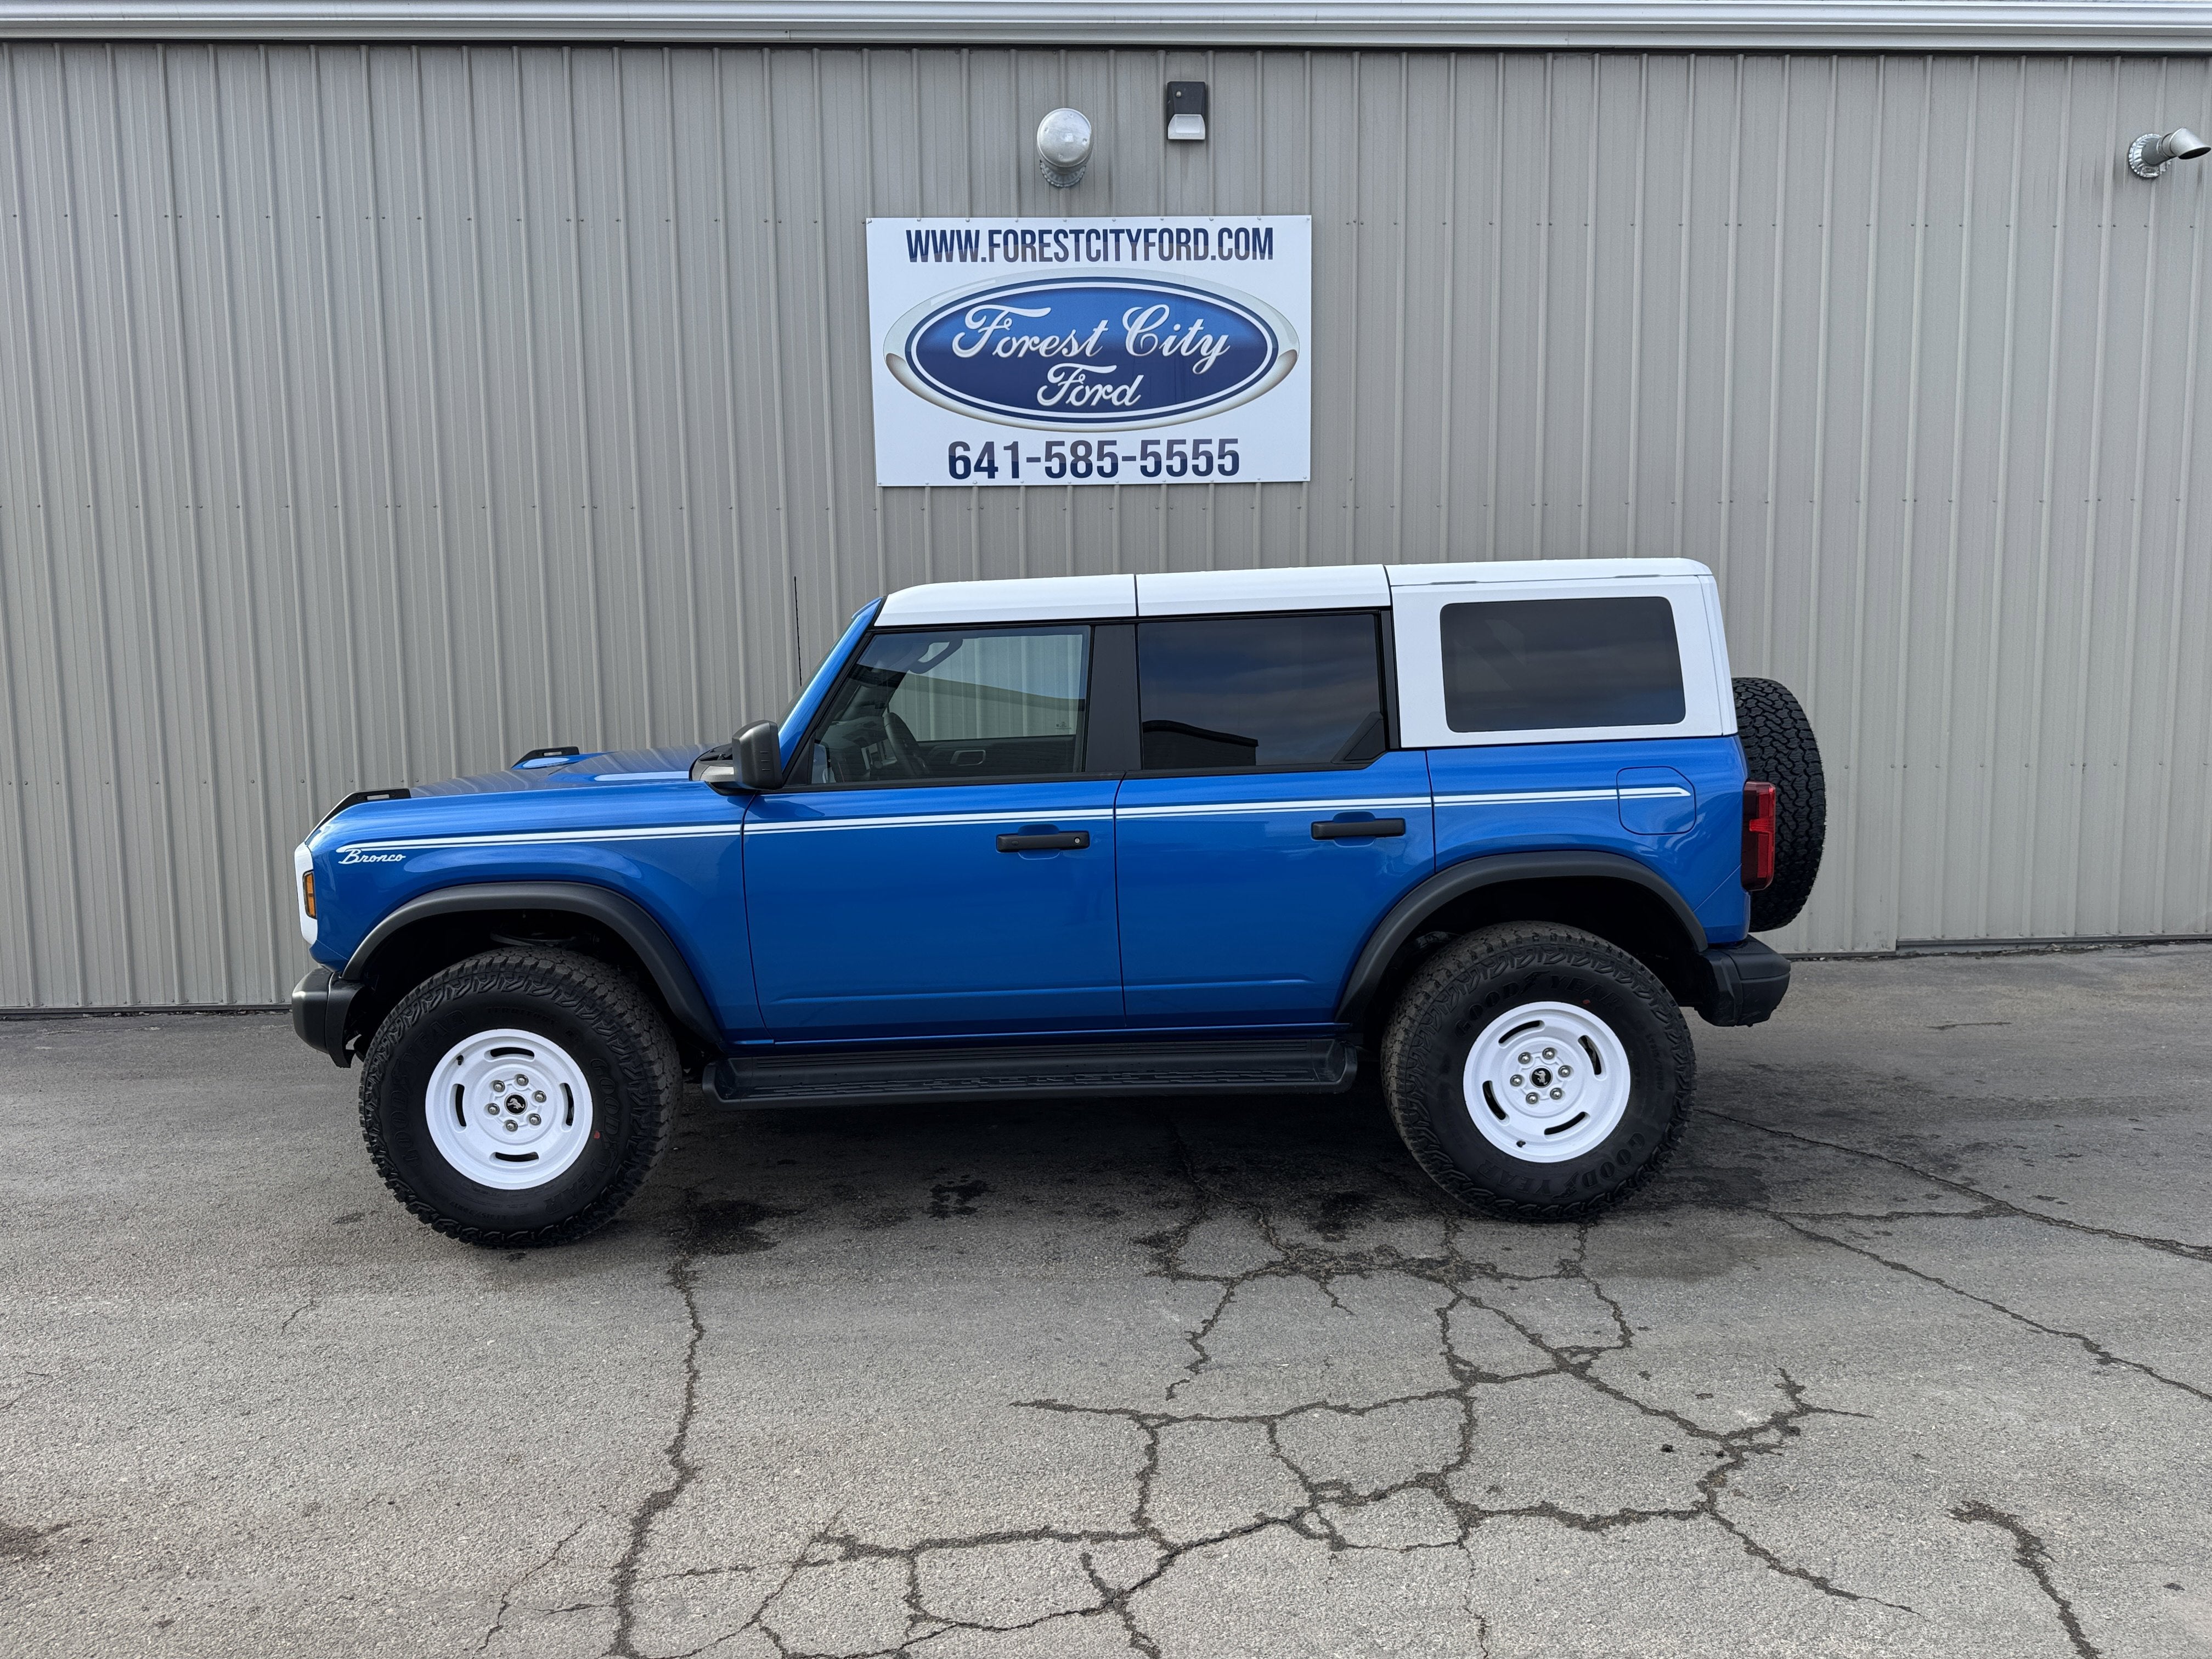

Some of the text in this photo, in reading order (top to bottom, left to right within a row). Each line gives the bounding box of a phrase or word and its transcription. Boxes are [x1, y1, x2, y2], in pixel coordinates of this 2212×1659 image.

[906, 228, 1274, 262] WWW.FORESTCITYFORD.COM
[951, 303, 1231, 375] Forest City
[1036, 363, 1142, 407] Ford
[948, 438, 1240, 480] 641-585-5555
[338, 849, 406, 864] Bronco
